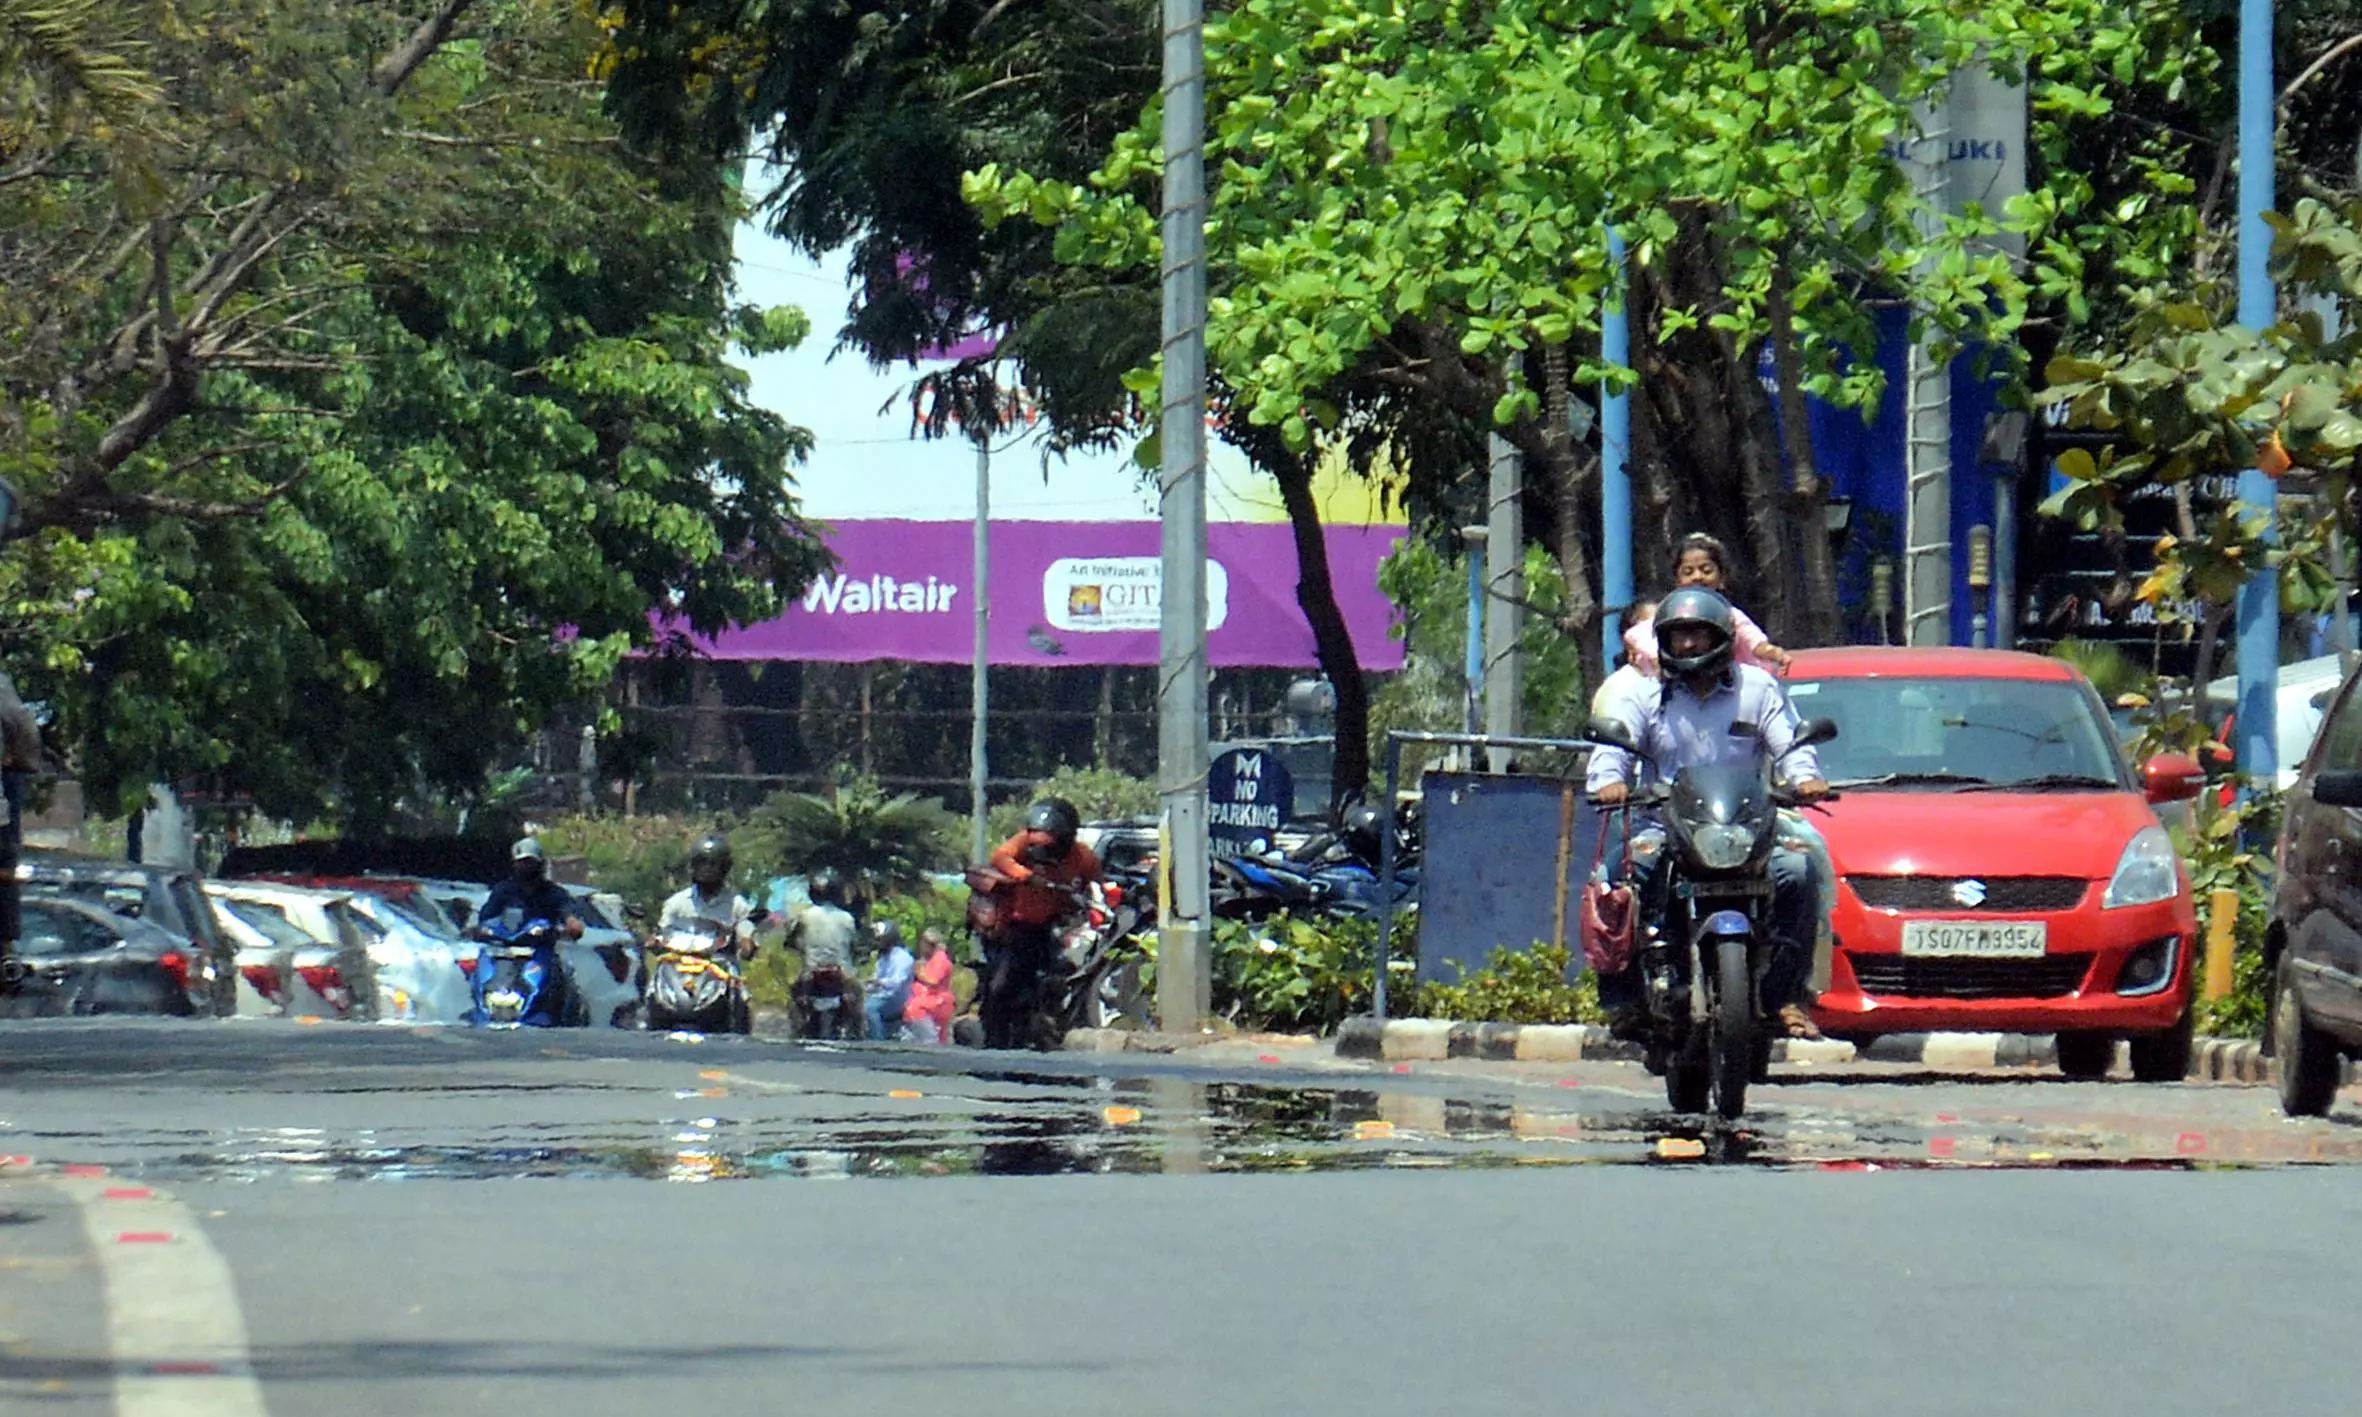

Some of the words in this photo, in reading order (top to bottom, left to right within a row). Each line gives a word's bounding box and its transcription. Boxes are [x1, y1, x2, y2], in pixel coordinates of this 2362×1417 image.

[803, 572, 958, 615] Waltair
[1105, 583, 1161, 606] GIT
[1234, 779, 1258, 800] NO
[1210, 802, 1279, 829] PARKING
